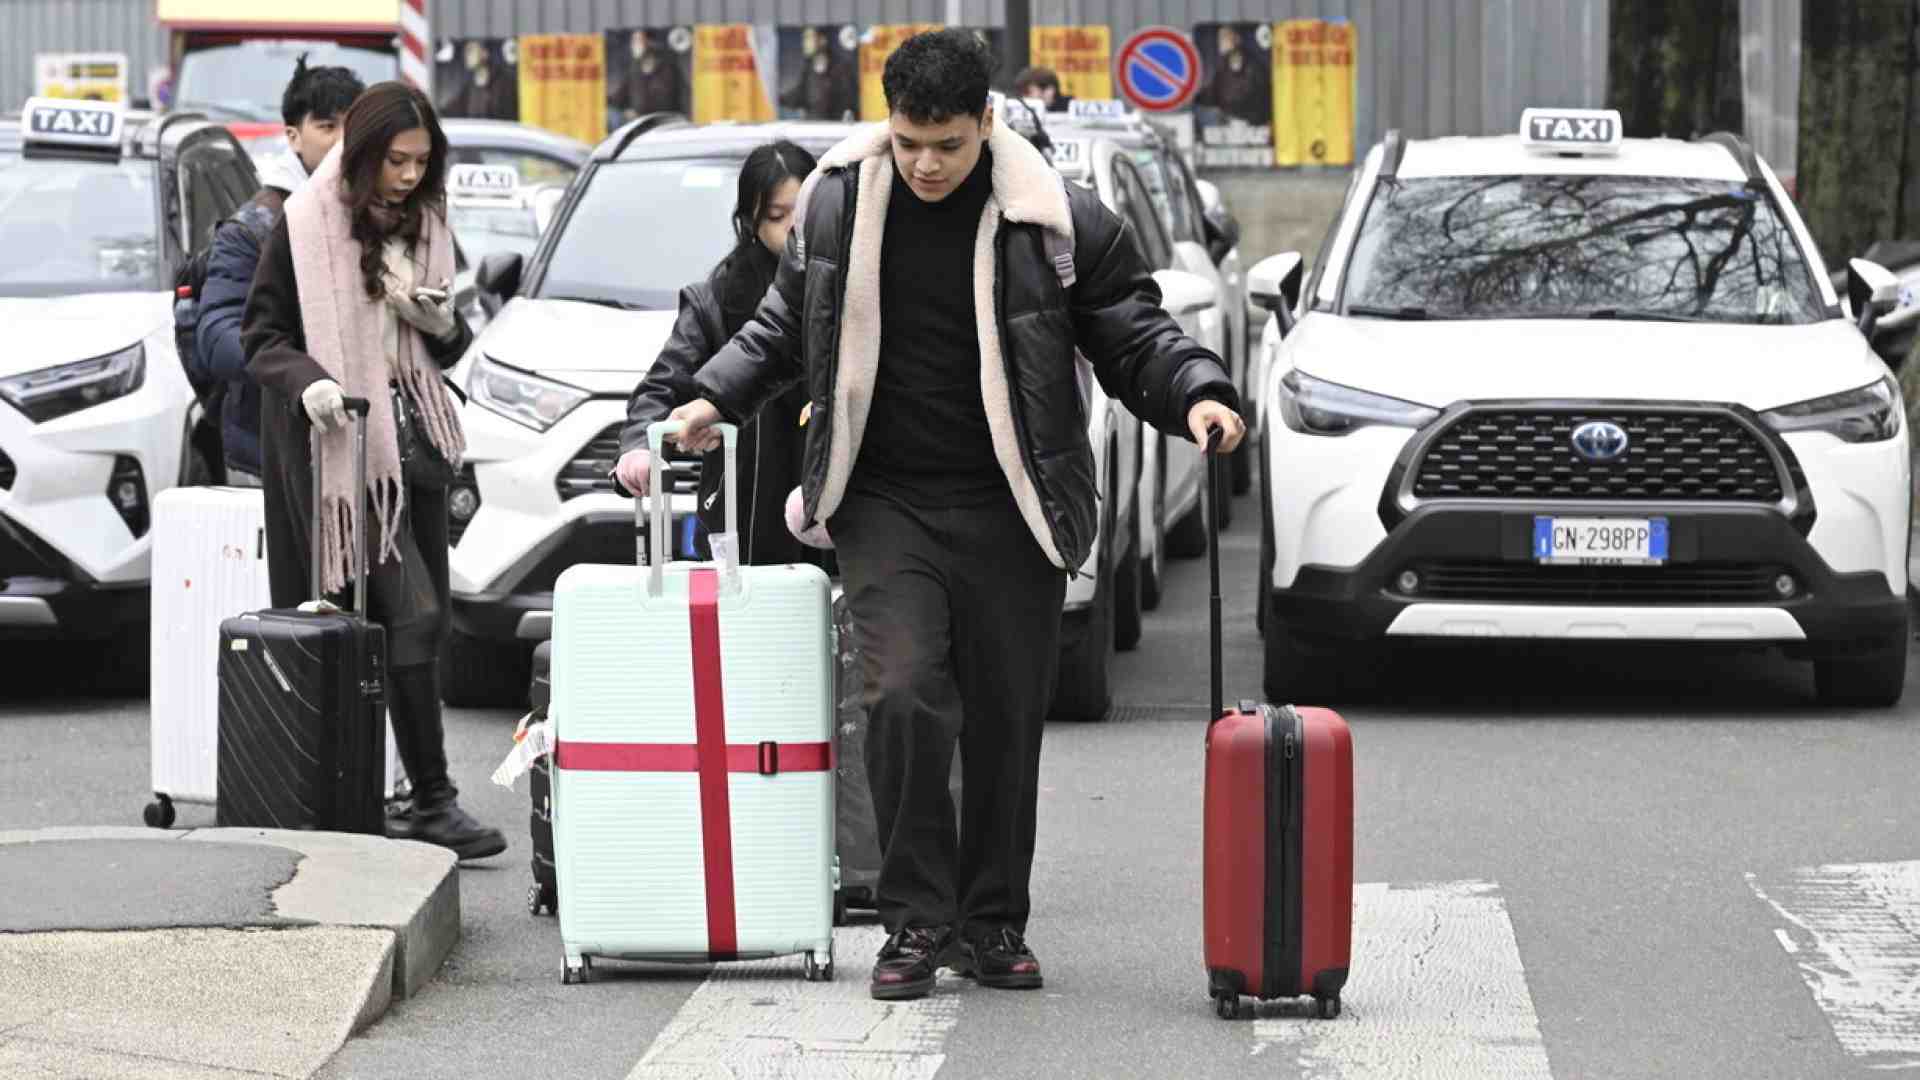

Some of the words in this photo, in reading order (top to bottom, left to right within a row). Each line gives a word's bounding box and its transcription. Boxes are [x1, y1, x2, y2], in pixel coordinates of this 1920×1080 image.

[34, 109, 112, 136] TAXI
[1533, 119, 1609, 139] TAXI
[455, 170, 511, 187] TAXI
